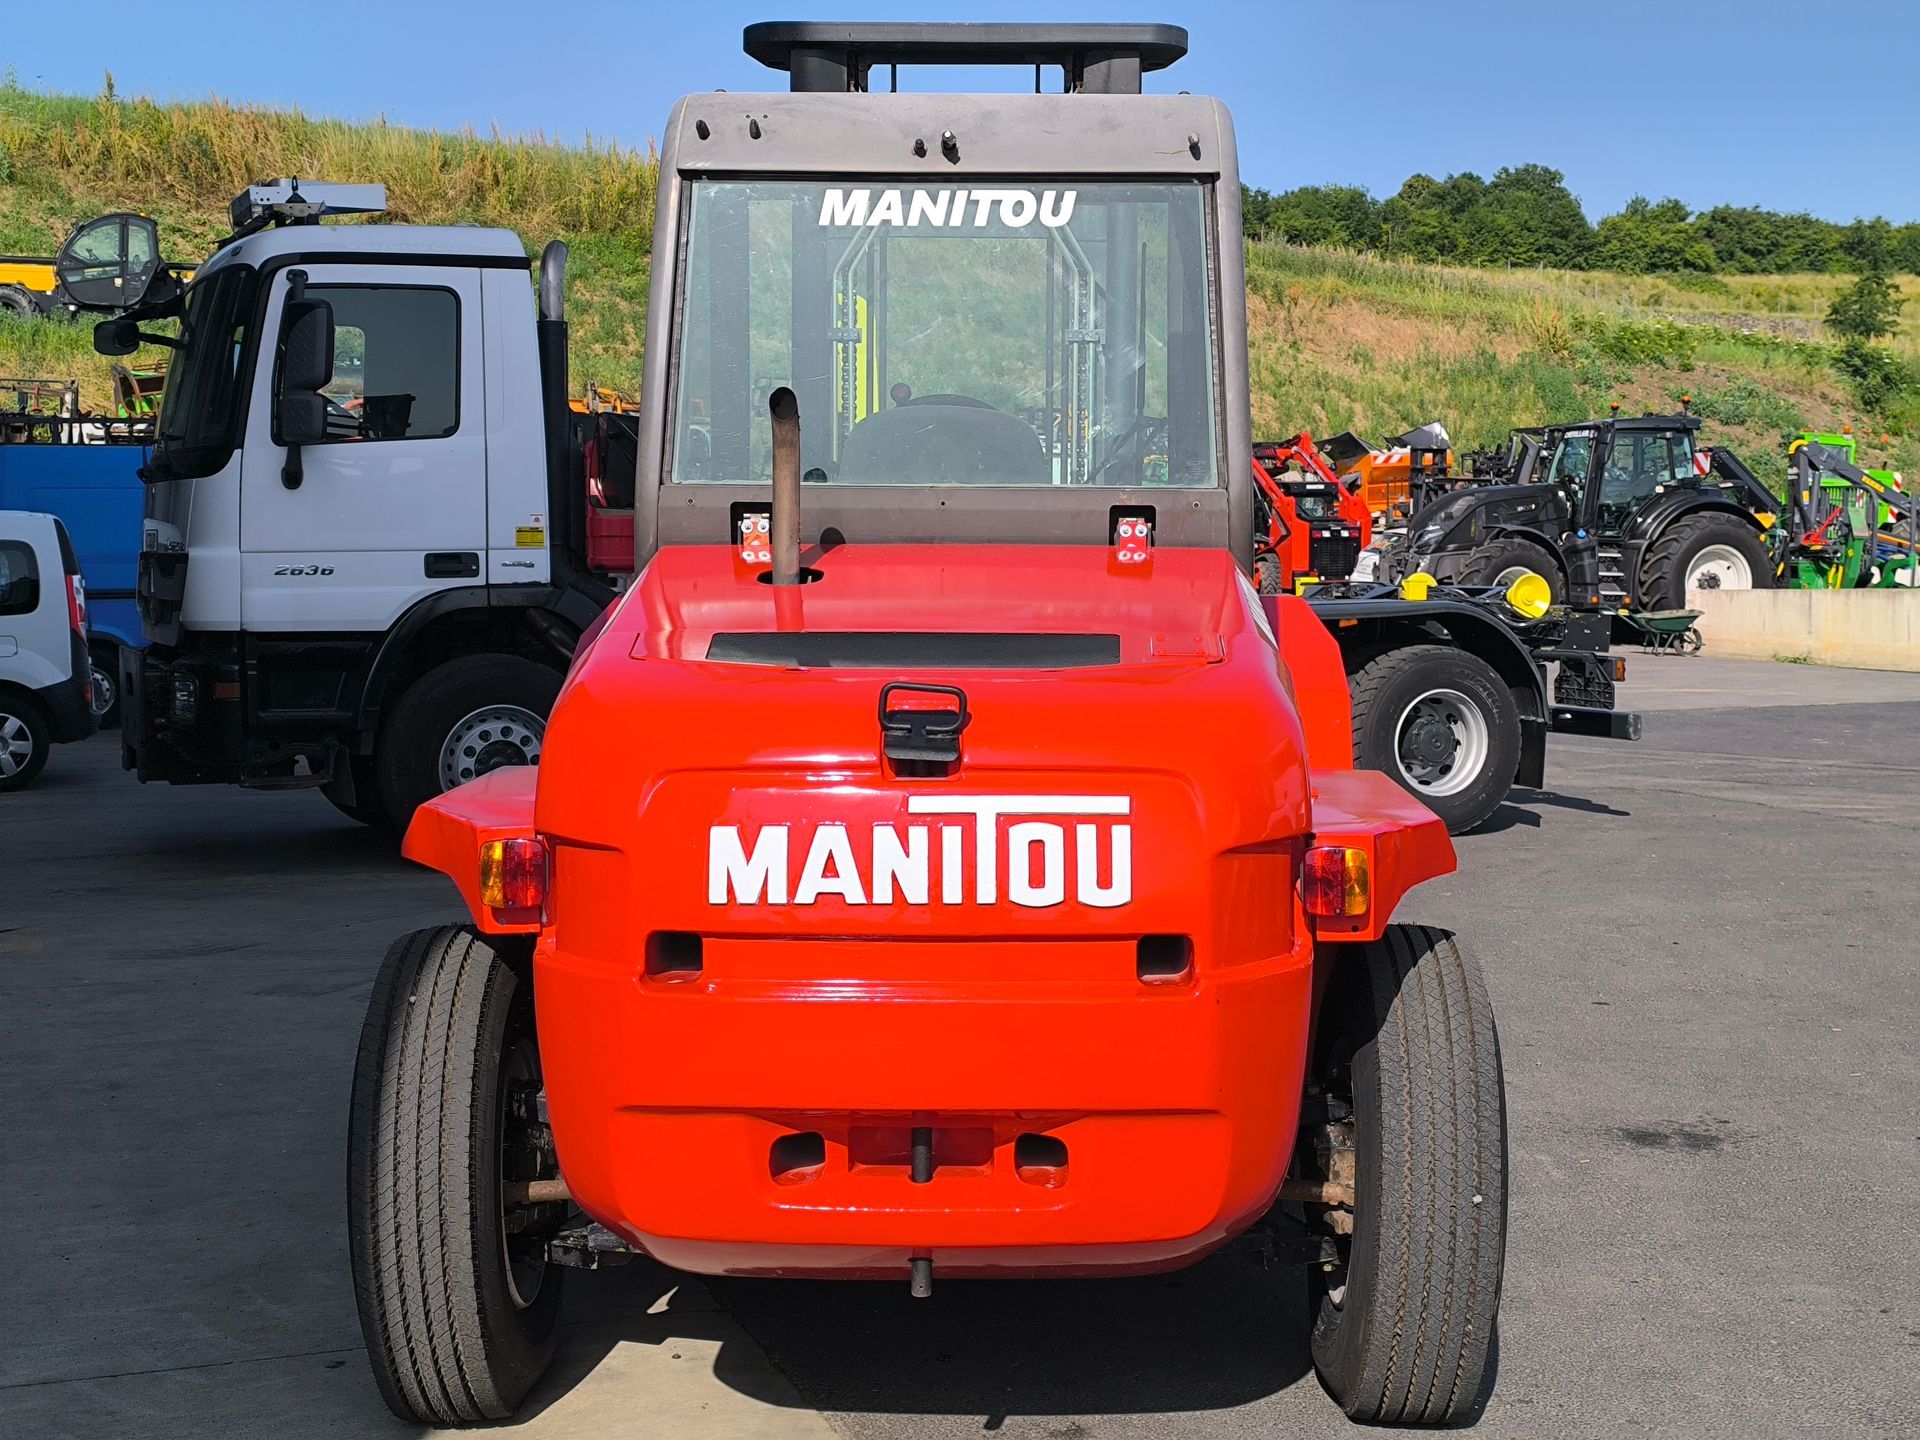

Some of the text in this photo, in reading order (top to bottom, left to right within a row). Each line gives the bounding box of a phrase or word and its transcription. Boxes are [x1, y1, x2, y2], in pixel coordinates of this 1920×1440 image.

[818, 189, 1077, 227] MANITOU
[274, 565, 335, 576] 2636
[709, 795, 1131, 907] MANITOU
